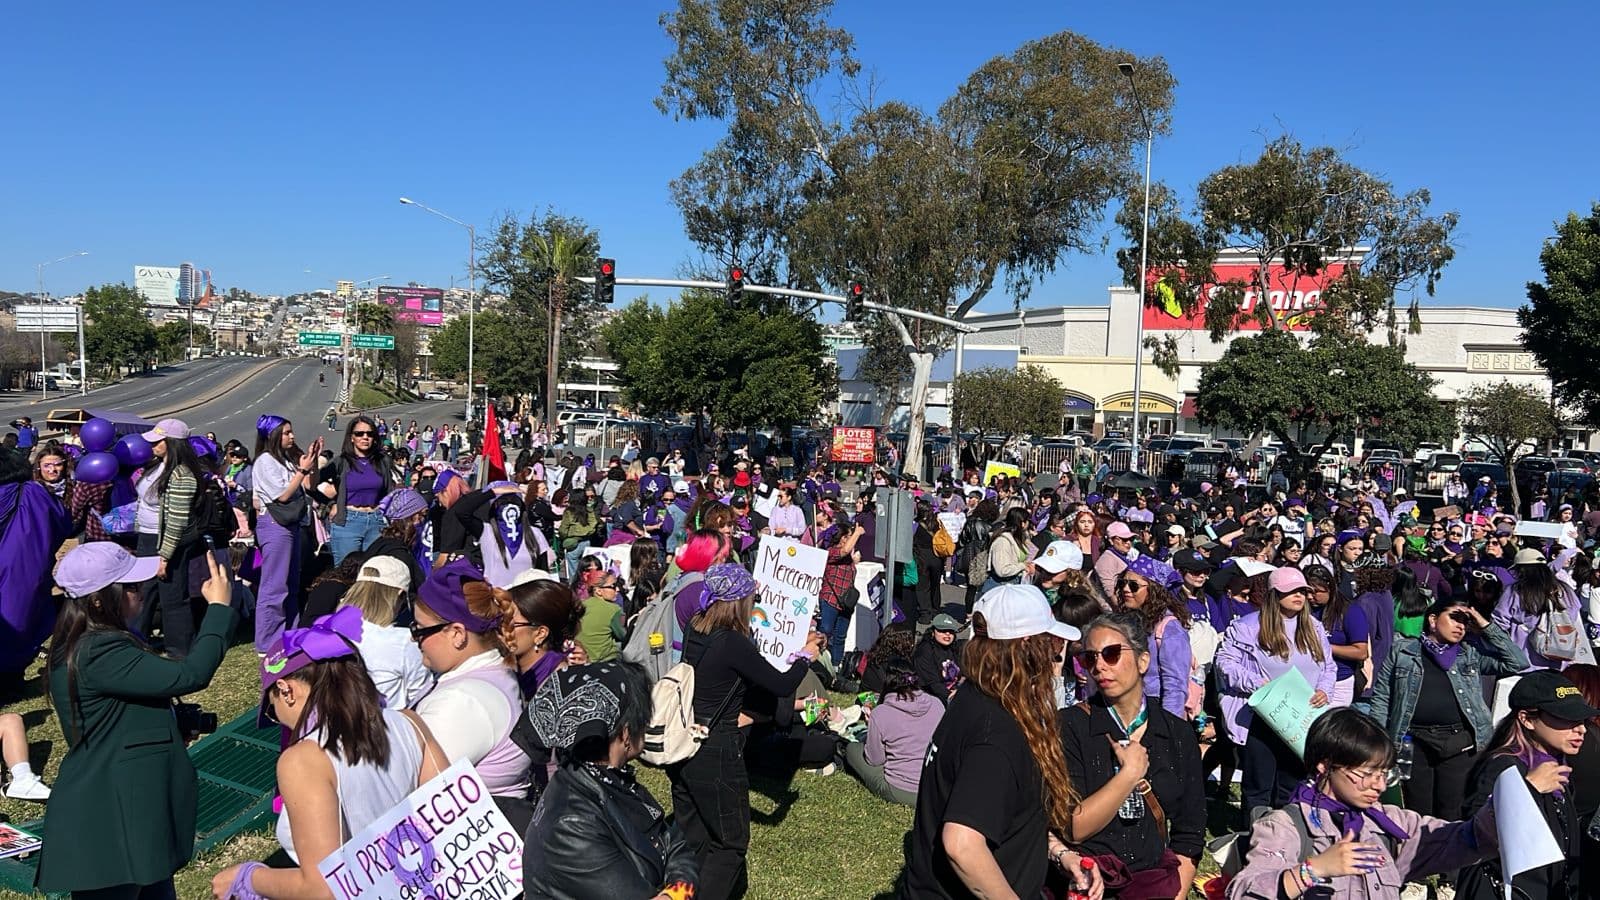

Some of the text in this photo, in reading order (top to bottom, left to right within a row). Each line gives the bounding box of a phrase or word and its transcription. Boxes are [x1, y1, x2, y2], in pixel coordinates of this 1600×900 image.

[1120, 401, 1146, 409] PERCT
[836, 430, 872, 438] ELOTES
[773, 611, 796, 637] Sin
[355, 774, 481, 885] PRIVILEGIO
[443, 809, 495, 871] poder
